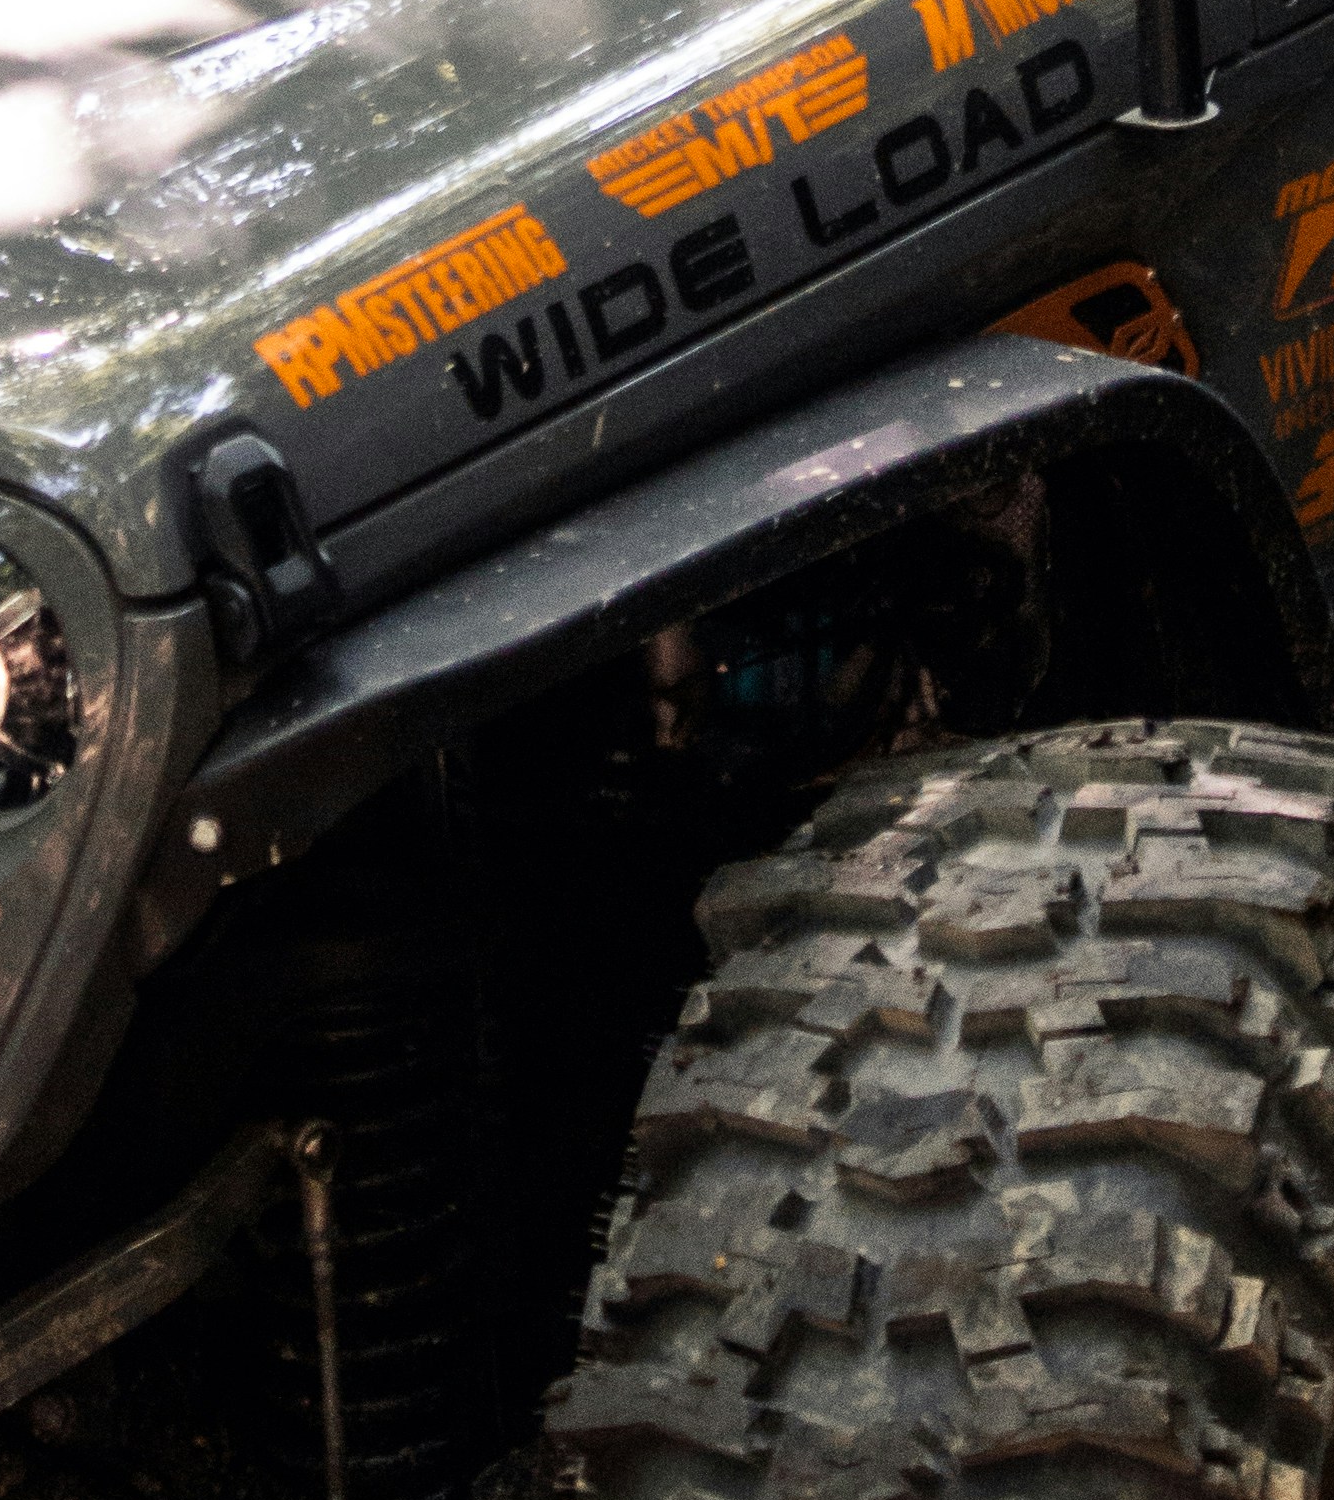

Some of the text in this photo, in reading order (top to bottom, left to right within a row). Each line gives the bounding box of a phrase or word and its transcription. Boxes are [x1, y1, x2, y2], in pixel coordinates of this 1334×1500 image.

[585, 33, 857, 182] MICKEY THOMPSON
[682, 90, 811, 188] M/T
[252, 201, 569, 410] RPMSTEERING
[450, 37, 1095, 422] WIDE LOAD
